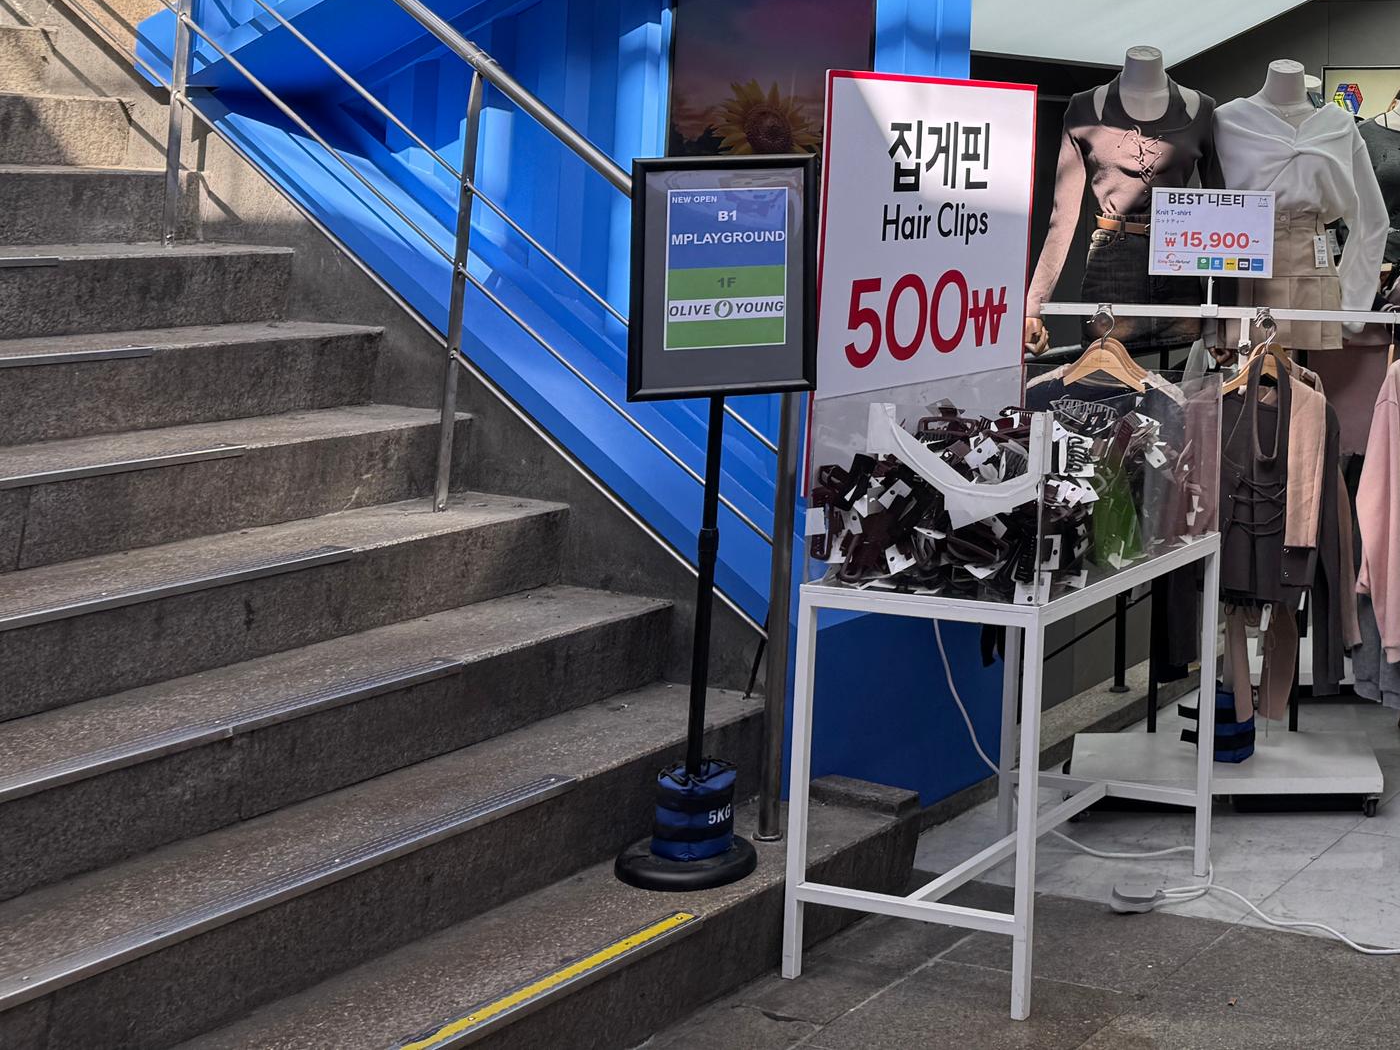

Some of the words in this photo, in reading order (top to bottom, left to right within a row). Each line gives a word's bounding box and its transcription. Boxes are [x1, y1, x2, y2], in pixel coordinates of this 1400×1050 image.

[888, 119, 991, 192] 집게핀
[671, 196, 692, 204] NEW
[1168, 192, 1204, 205] BEST
[1208, 193, 1245, 208] 니트티
[717, 210, 738, 222] B1
[881, 203, 932, 242] Hair
[937, 202, 989, 245] Clips
[671, 230, 785, 245] MPLAYGROUND
[717, 276, 737, 289] 1F
[669, 304, 712, 317] OLIVE
[735, 301, 784, 314] YOUNG
[708, 803, 731, 825] 5KG
